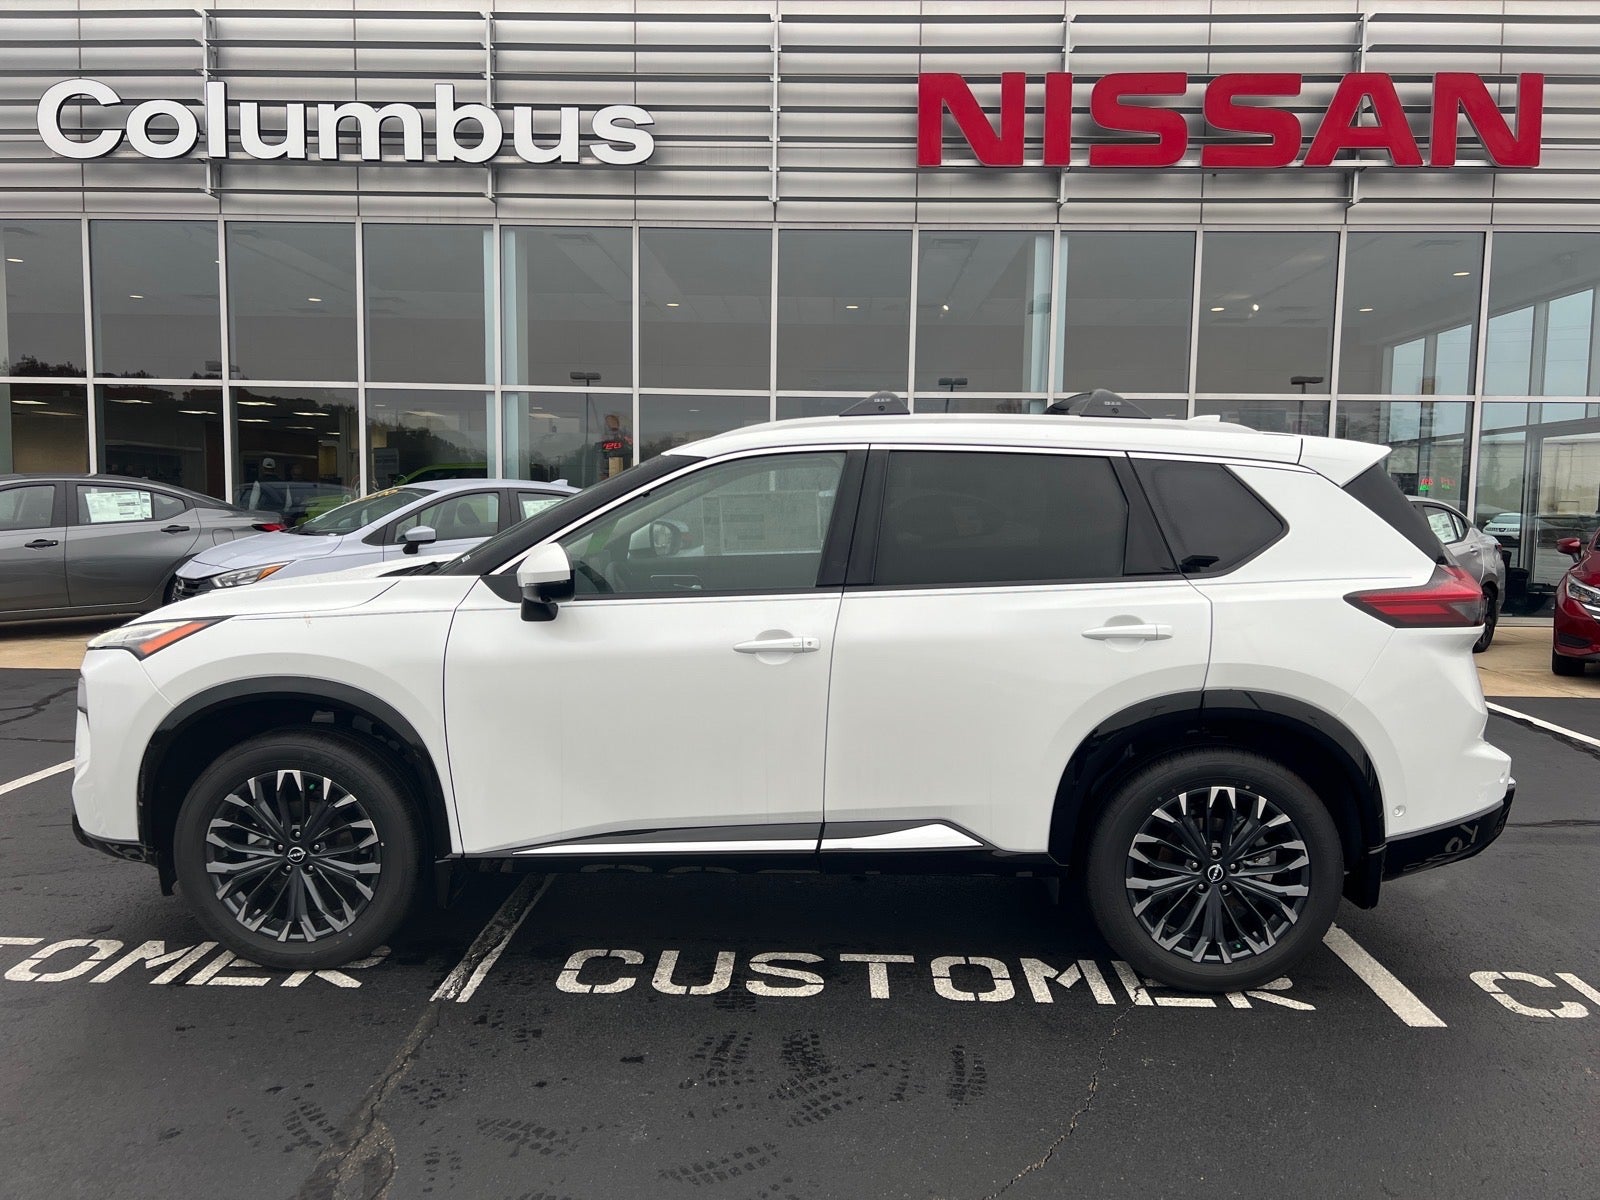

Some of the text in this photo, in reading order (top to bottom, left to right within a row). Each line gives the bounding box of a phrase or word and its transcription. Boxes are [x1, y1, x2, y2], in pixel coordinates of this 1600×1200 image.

[37, 78, 655, 165] Columbus
[917, 72, 1544, 167] NISSAN
[555, 948, 1316, 1012] CUSTOMER
